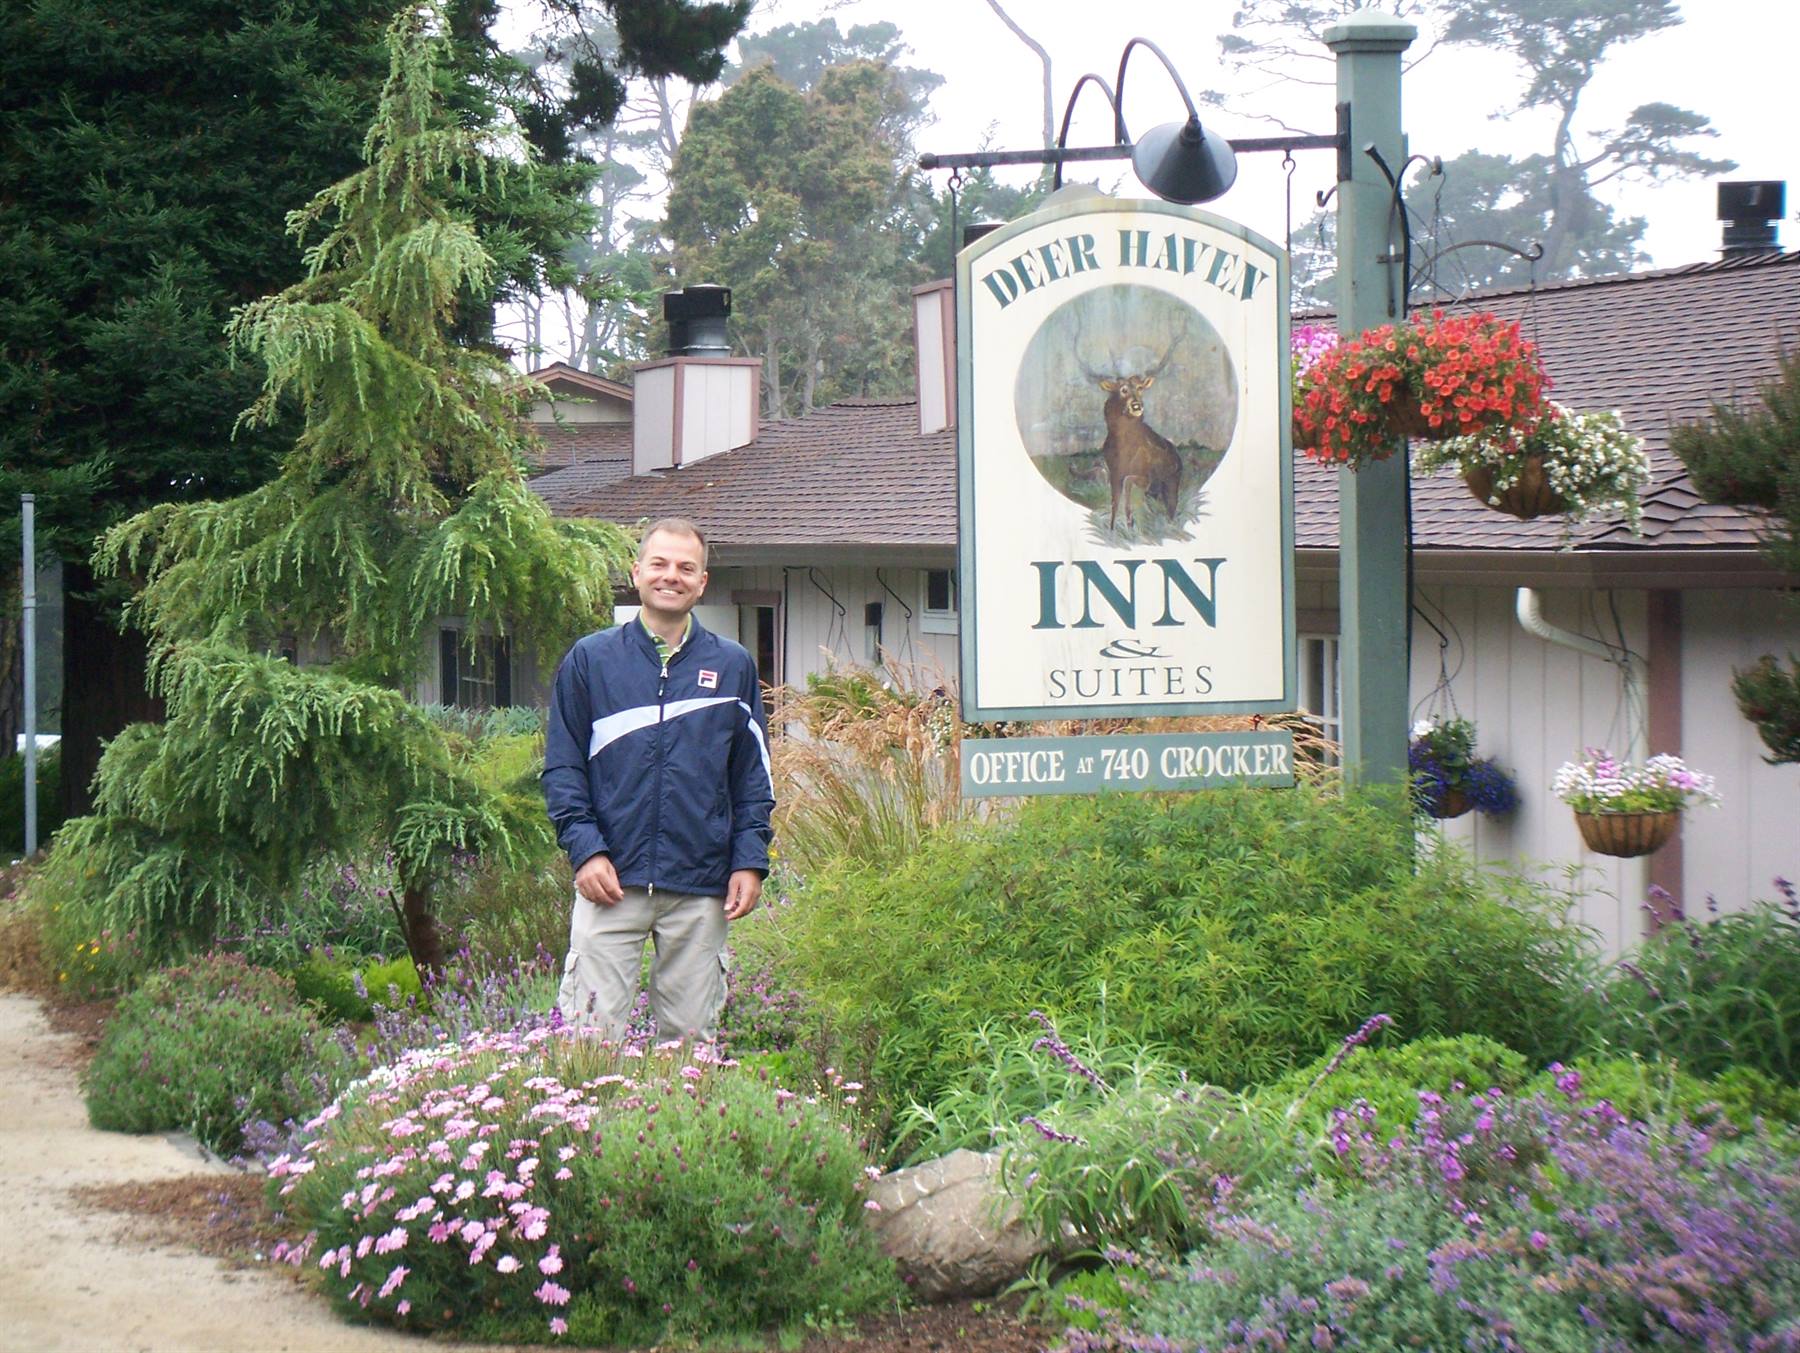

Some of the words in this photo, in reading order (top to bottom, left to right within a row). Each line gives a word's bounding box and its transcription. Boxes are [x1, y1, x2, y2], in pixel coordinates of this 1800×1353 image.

[981, 233, 1101, 309] DEER
[1118, 230, 1270, 301] HAVEN
[1030, 558, 1227, 630] INN
[1099, 639, 1173, 659] &
[1050, 666, 1213, 698] SUITES
[970, 750, 1065, 784] OFFICE
[1076, 757, 1094, 774] AT
[1101, 748, 1149, 780] 740
[1160, 744, 1290, 779] CROCKER
